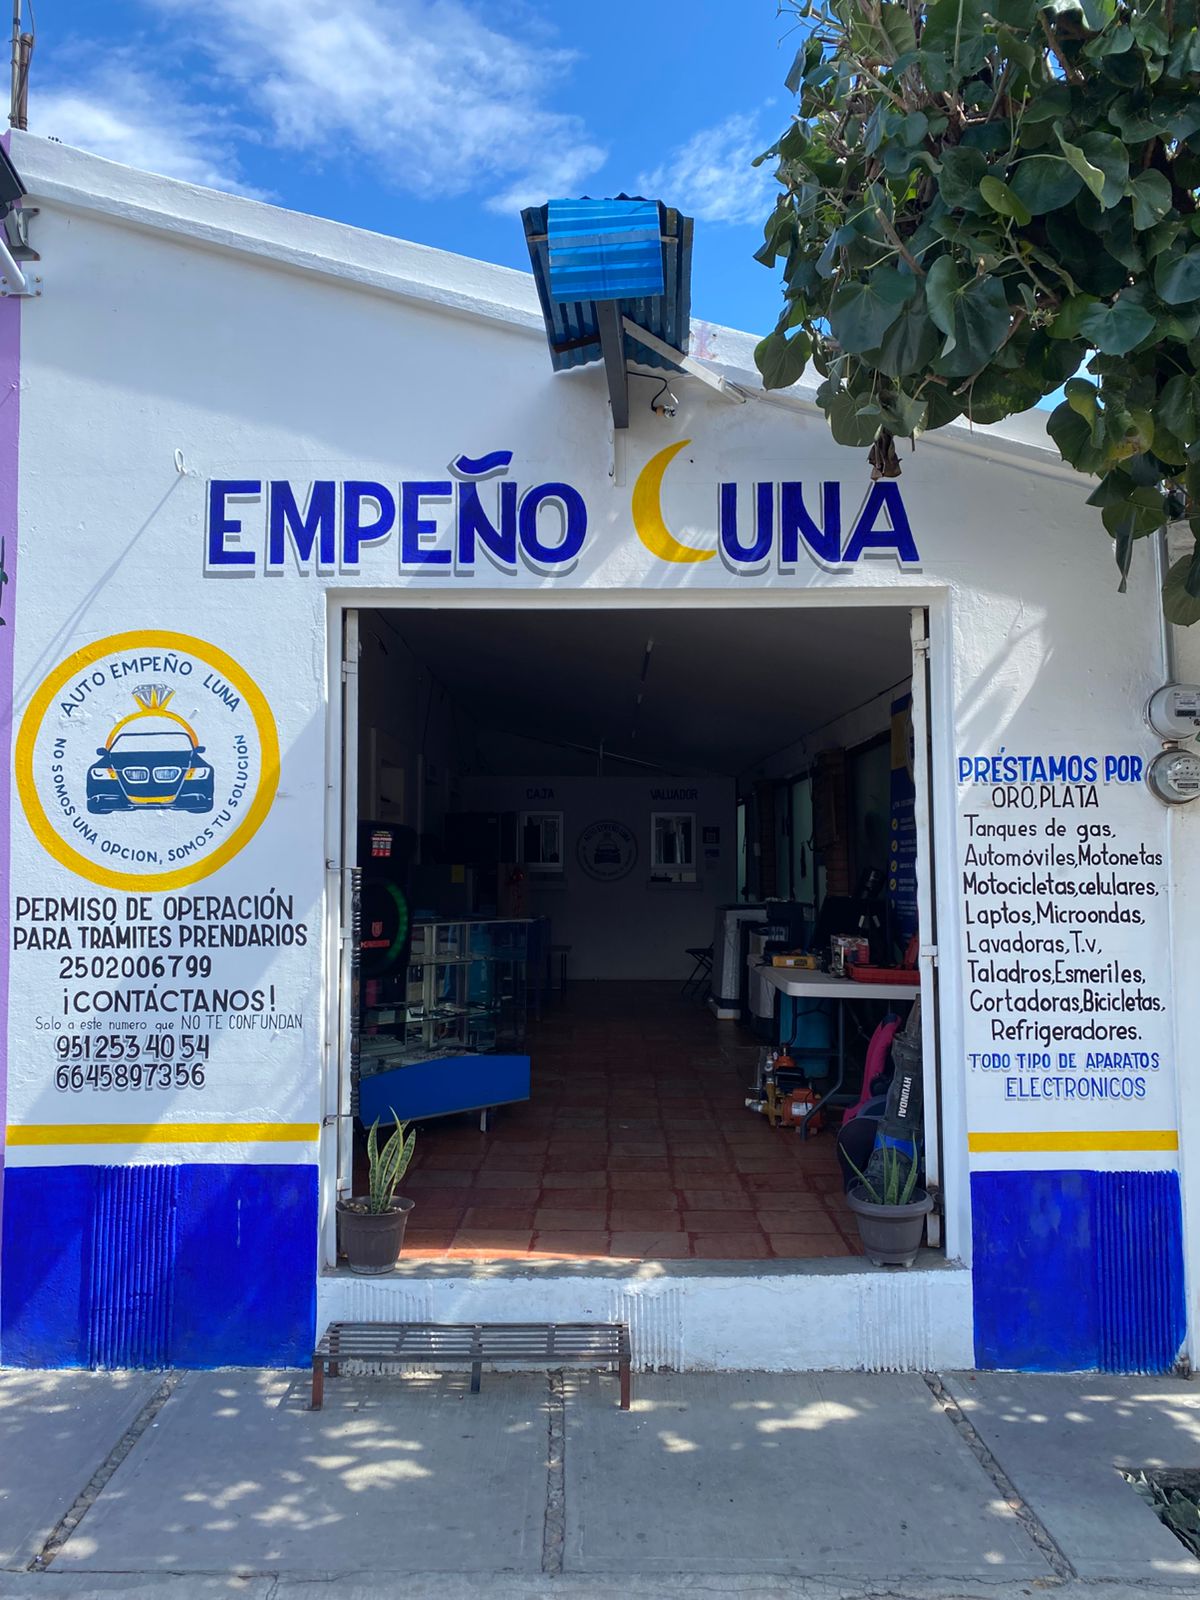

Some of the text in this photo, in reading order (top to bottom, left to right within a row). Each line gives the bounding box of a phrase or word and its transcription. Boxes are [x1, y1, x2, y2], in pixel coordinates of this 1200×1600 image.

[206, 451, 588, 569] EMPEÑO
[60, 653, 241, 717] AUTO EMPEÑO LUNA
[958, 747, 1143, 784] PRÉSTAMOS POR
[52, 734, 249, 865] NO SOMOS UNA OPCION, SOMOS TU SOLUCIÓN
[650, 789, 698, 800] VALUADOR
[963, 814, 1116, 843] Tanques de gas,
[15, 887, 293, 921] PERMISO DE OPERACIÓN
[13, 921, 308, 950] PARA TRÁMITES PRENDARIOS
[59, 955, 212, 979] 2502006799
[63, 983, 276, 1015] ¡CONTÁCTANOS!
[35, 1014, 303, 1033] Solo a este numero que NO TE CONFUNDAN
[991, 1019, 1142, 1048] Refrigeradores.
[968, 1052, 1160, 1070] TODO TIPO DE APARATOS
[56, 1063, 206, 1090] 6645897356
[1006, 1076, 1148, 1099] ELECTRONICOS
[898, 1076, 912, 1118] HYUNDAI
